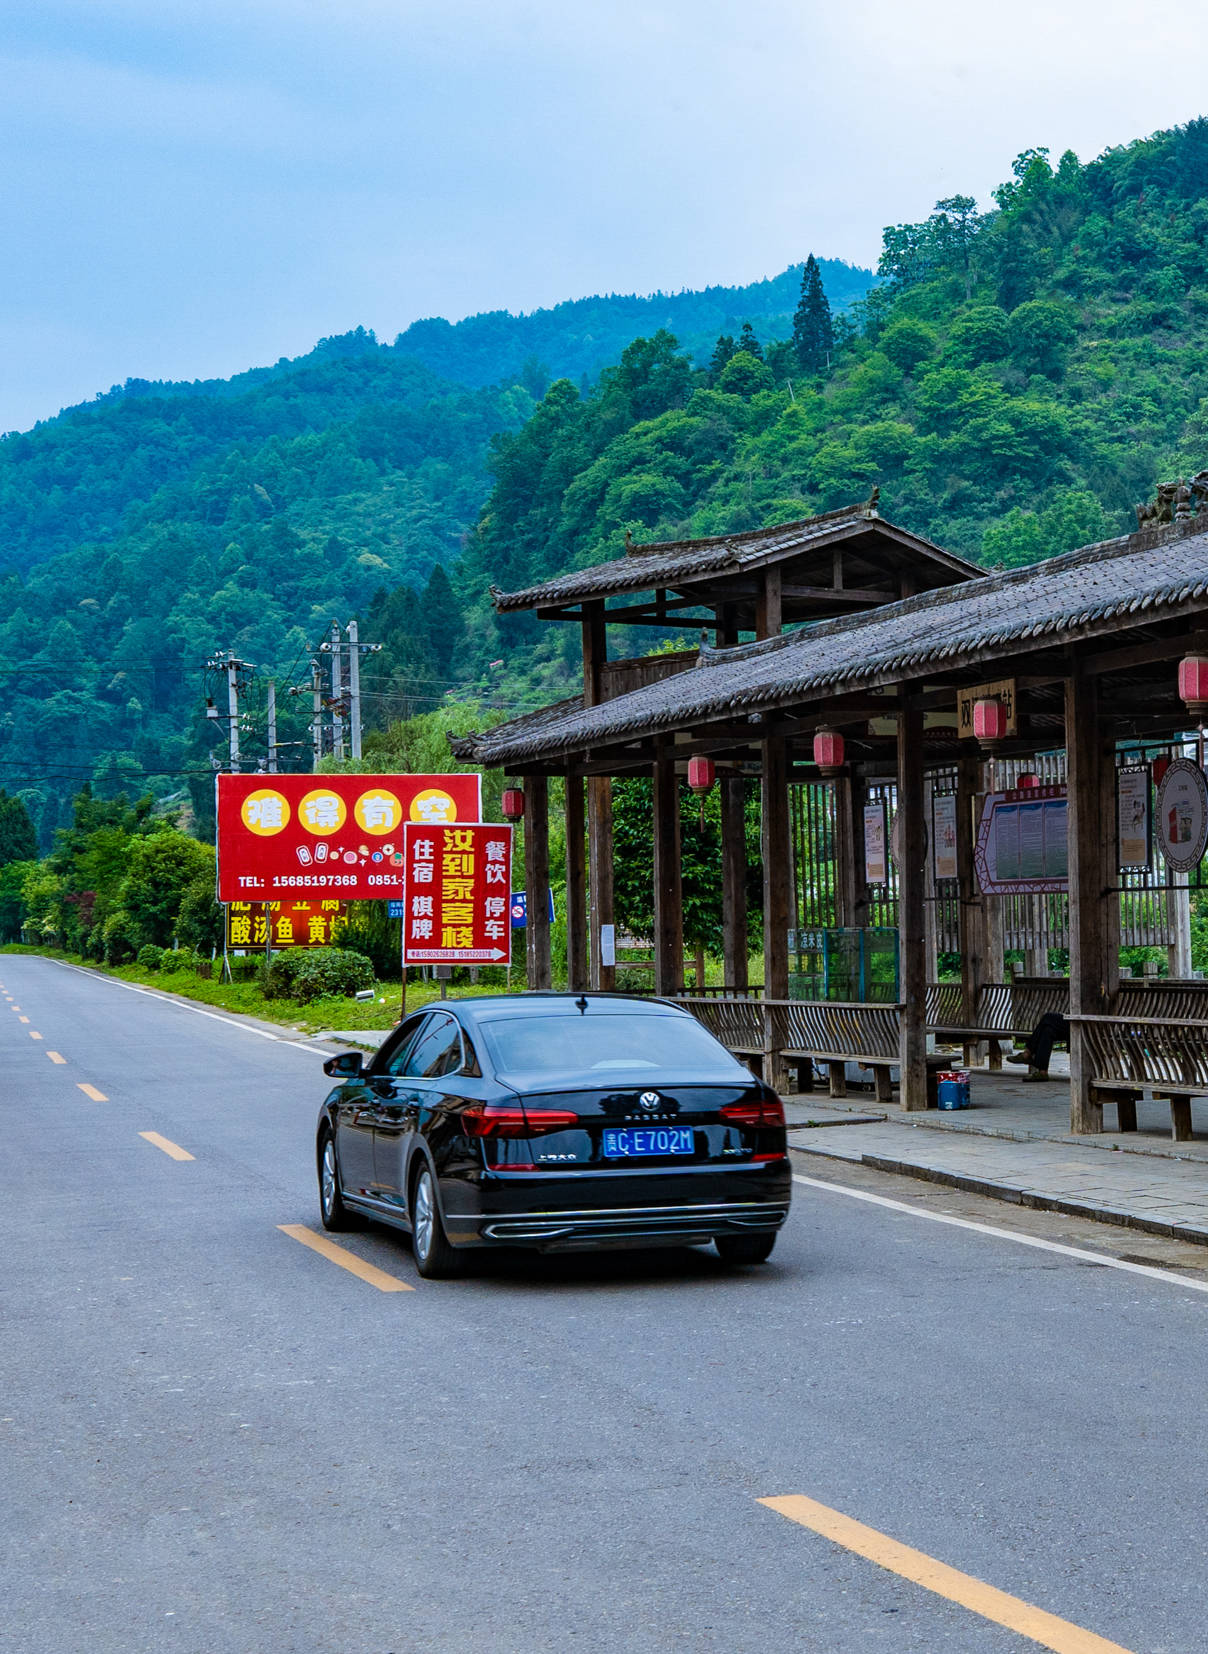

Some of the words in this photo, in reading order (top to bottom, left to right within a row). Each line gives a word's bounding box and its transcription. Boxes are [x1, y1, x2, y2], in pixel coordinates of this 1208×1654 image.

[247, 796, 451, 827] 难得有空
[239, 876, 265, 888] TEL:
[272, 875, 358, 887] 15685197368
[367, 874, 405, 886] 0851-
[413, 839, 434, 883] 住宿
[484, 841, 507, 884] 餐饮
[441, 829, 475, 949] 汝到家客栈
[411, 896, 434, 939] 棋牌
[484, 897, 505, 940] 停车
